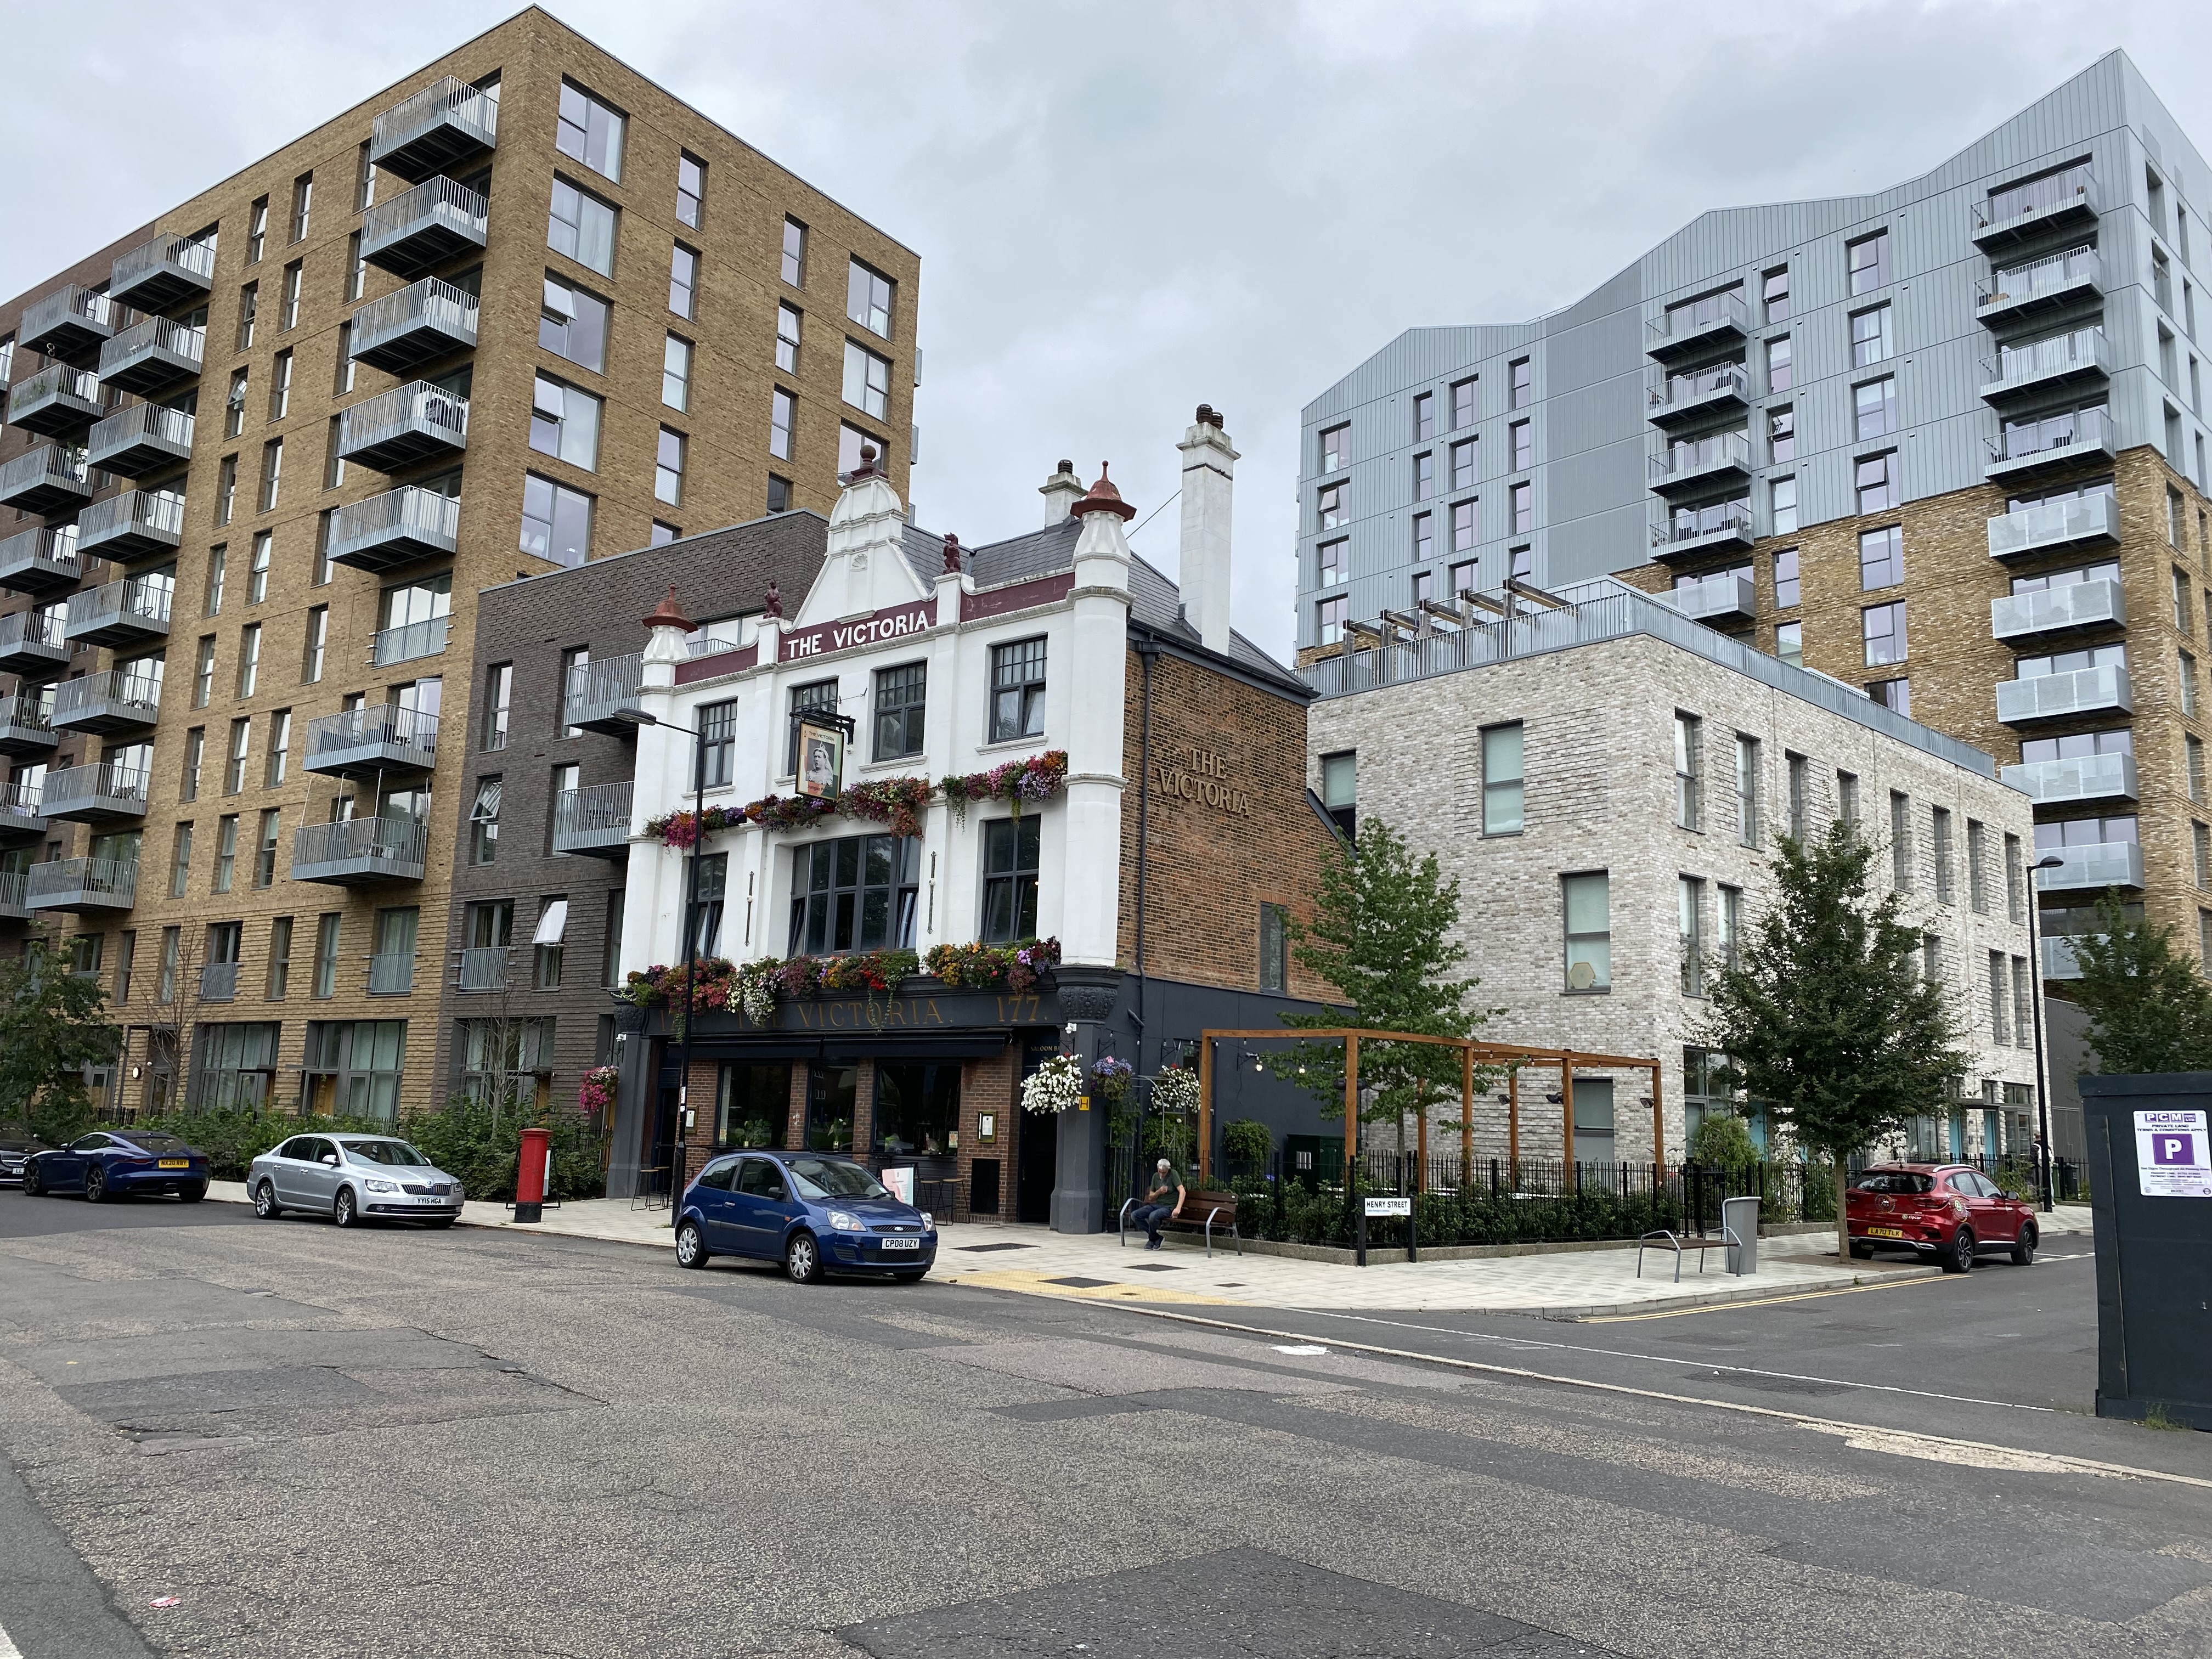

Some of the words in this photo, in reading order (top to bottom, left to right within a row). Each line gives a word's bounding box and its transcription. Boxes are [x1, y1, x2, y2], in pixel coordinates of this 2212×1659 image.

[787, 634, 822, 658] THE
[833, 610, 929, 648] VICTORIA
[817, 732, 834, 741] VICTORIA
[1189, 748, 1227, 780] THE
[1159, 768, 1251, 816] VICTORIA
[2165, 1139, 2182, 1159] P
[885, 1239, 904, 1248] CP08
